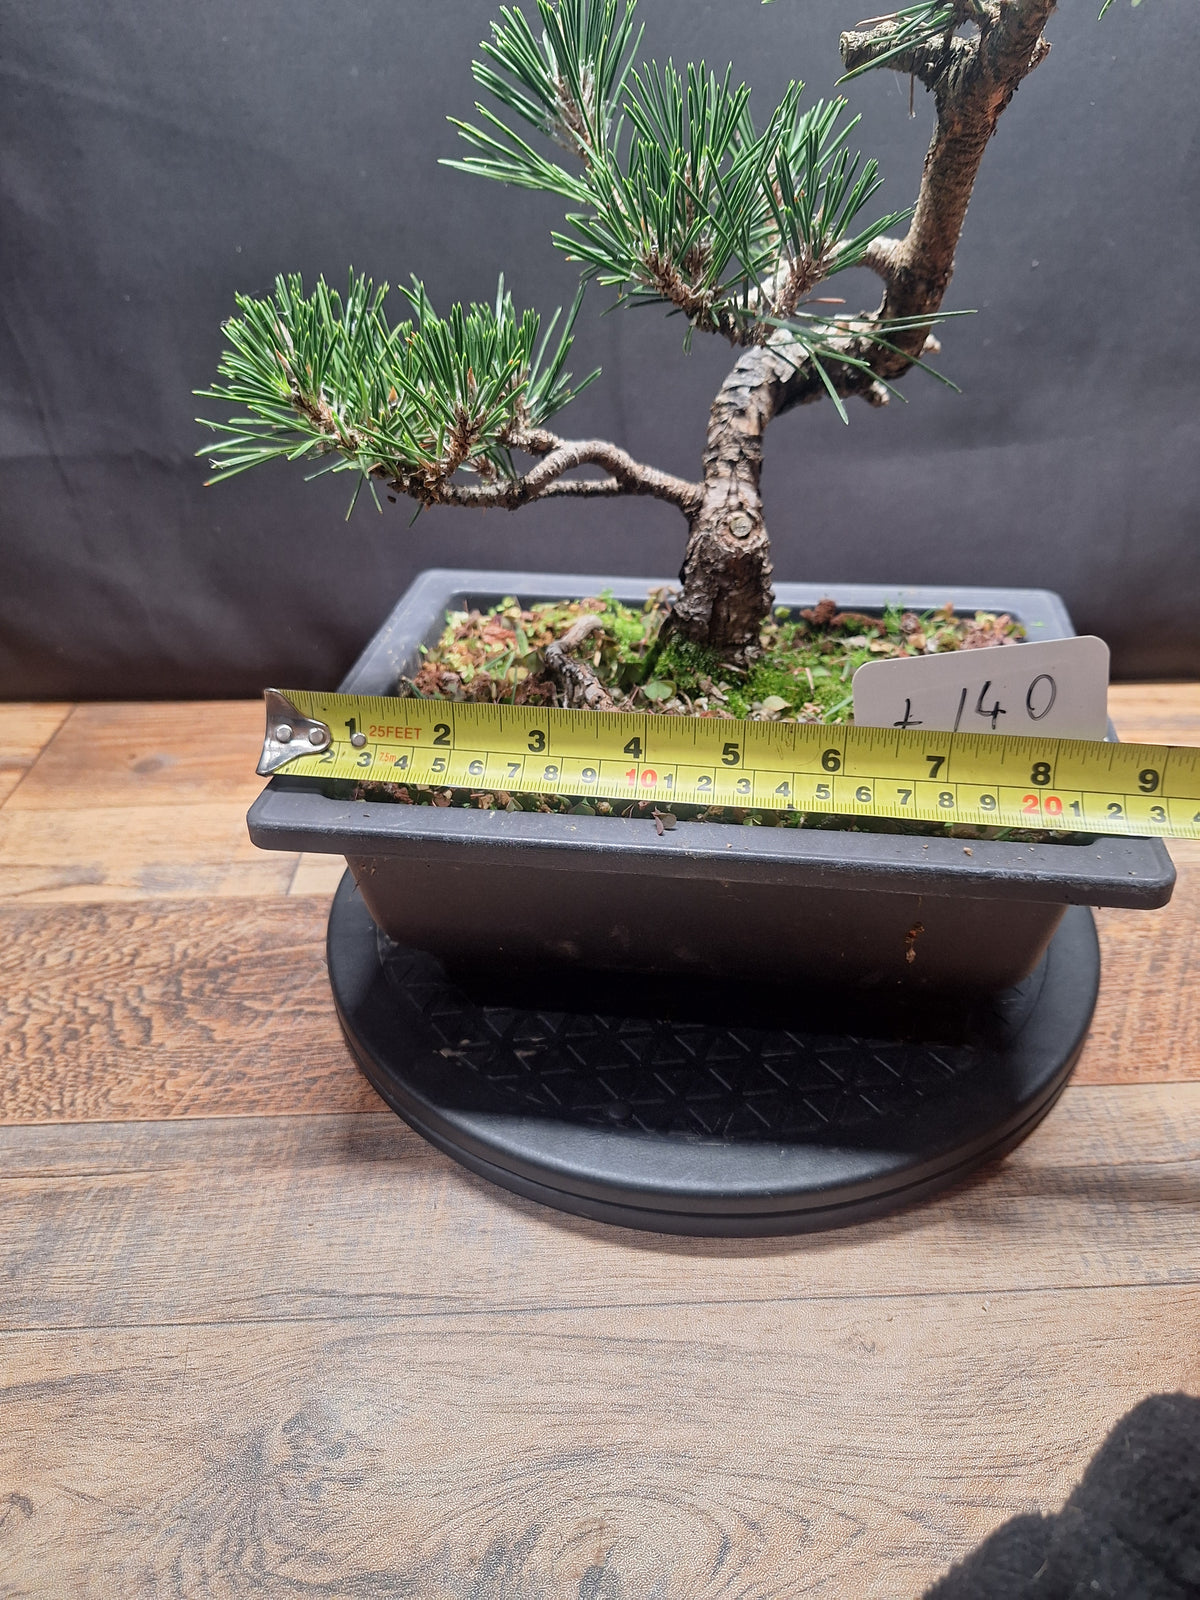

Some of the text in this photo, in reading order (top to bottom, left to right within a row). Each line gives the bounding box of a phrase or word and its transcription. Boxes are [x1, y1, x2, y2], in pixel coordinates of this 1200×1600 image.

[954, 674, 1056, 732] 140
[319, 749, 335, 764] 2
[357, 752, 372, 767] 3
[394, 755, 408, 770] 4
[431, 757, 446, 773] 5
[468, 760, 484, 775] 6
[507, 763, 521, 778] 7
[543, 765, 559, 781] 8
[581, 768, 596, 783] 9
[625, 768, 657, 788] 10
[664, 773, 673, 789] 1
[697, 775, 712, 791] 2
[736, 778, 751, 794] 3
[775, 781, 791, 797] 4
[815, 784, 830, 800] 5
[856, 786, 872, 802] 6
[897, 789, 912, 805] 7
[938, 792, 954, 808] 8
[980, 794, 996, 811] 9
[1022, 794, 1062, 816] 20
[1069, 800, 1081, 817] 1
[1107, 803, 1123, 820] 2
[1150, 805, 1166, 823] 3
[345, 717, 1159, 793] 1 25FEET 2 3 4 5 6 7 8 9
